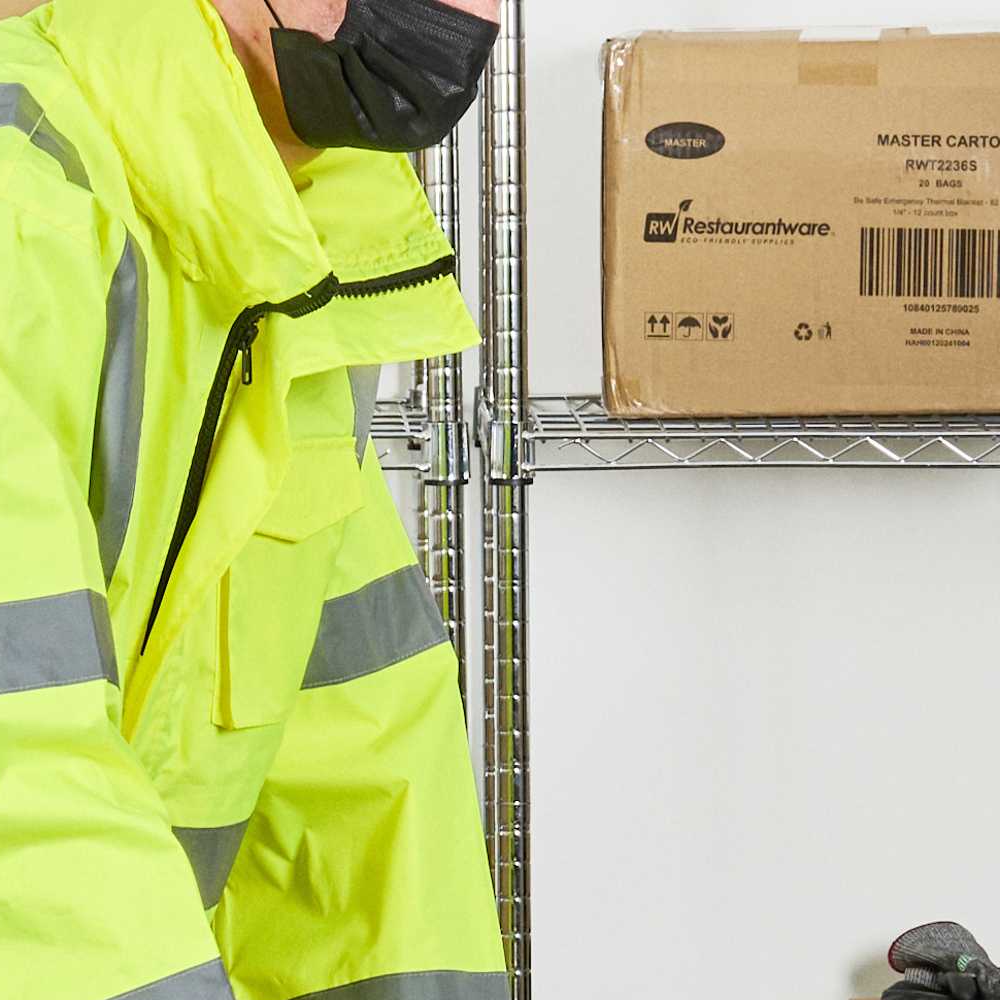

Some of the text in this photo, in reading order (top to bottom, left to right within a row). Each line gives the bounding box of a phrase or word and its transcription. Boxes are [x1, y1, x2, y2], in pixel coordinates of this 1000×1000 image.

[664, 138, 706, 149] MASTER
[877, 134, 1000, 148] MASTER CARTO
[905, 159, 977, 171] RWT2236S
[919, 179, 963, 188] 20 BAGS
[683, 217, 831, 236] Restaurantware
